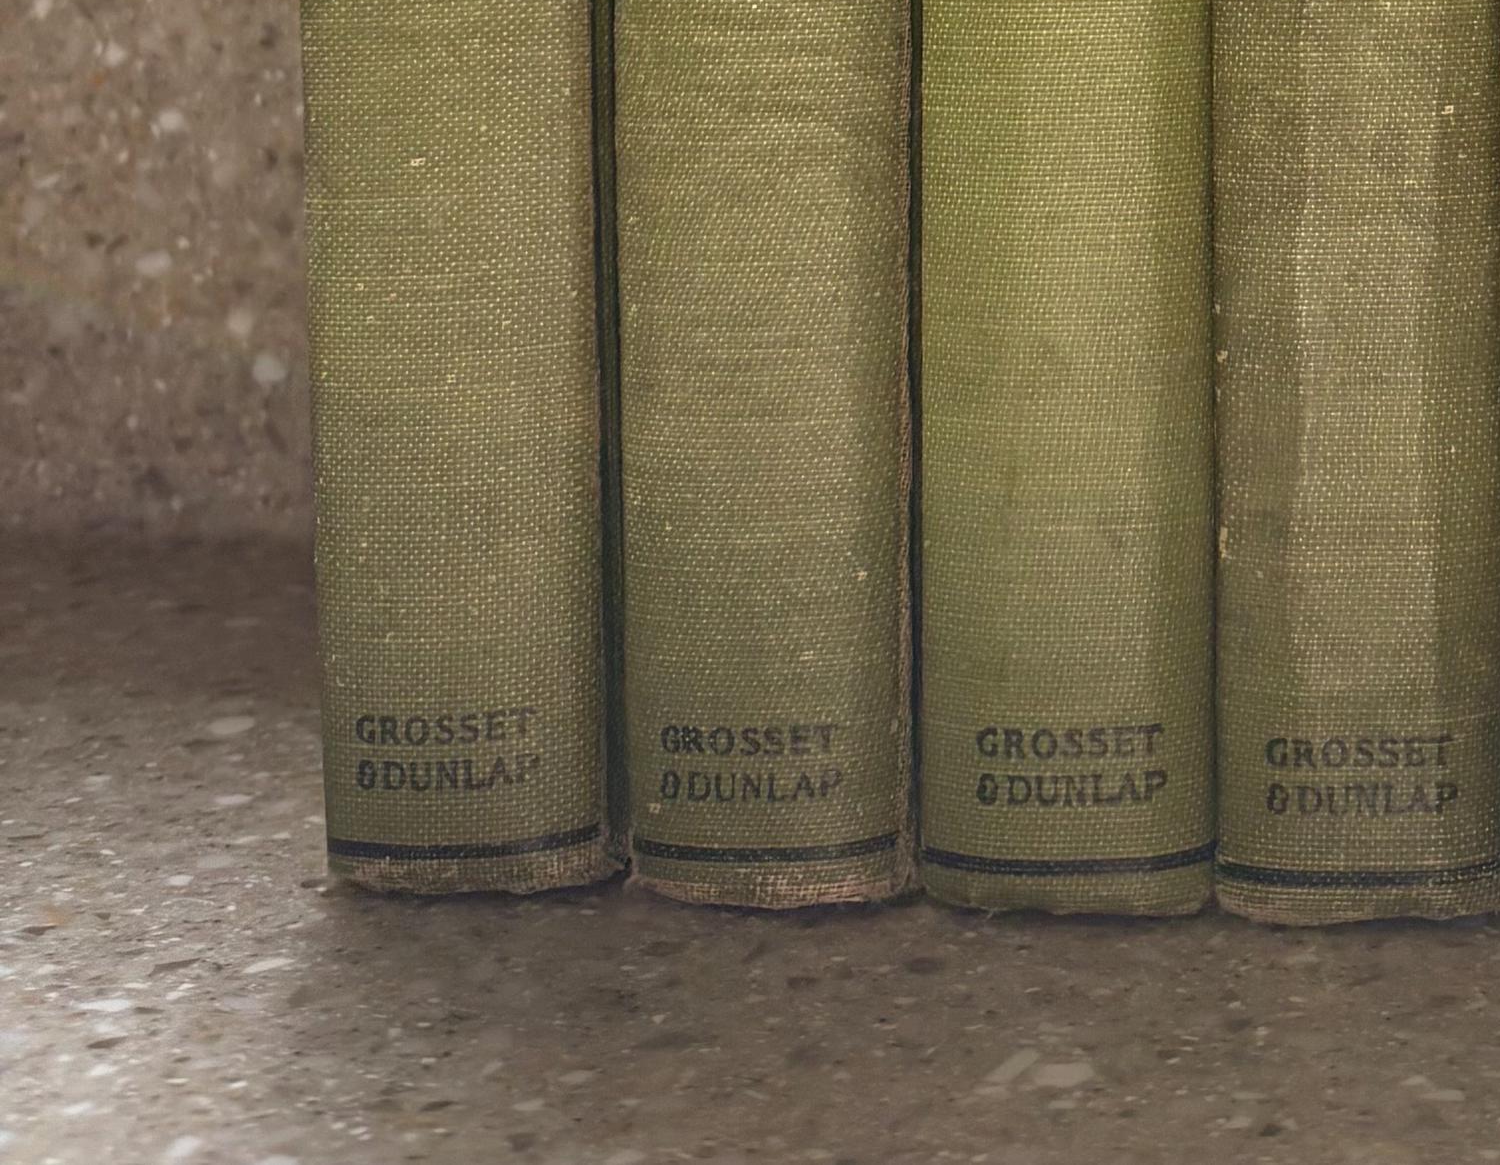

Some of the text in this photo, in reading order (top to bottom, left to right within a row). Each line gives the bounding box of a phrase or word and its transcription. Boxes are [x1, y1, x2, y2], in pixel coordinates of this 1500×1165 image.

[356, 707, 538, 747] GROSSET
[661, 723, 838, 755] GROSSET
[975, 723, 1165, 760] GROSSET
[1266, 736, 1454, 769] GROSSET
